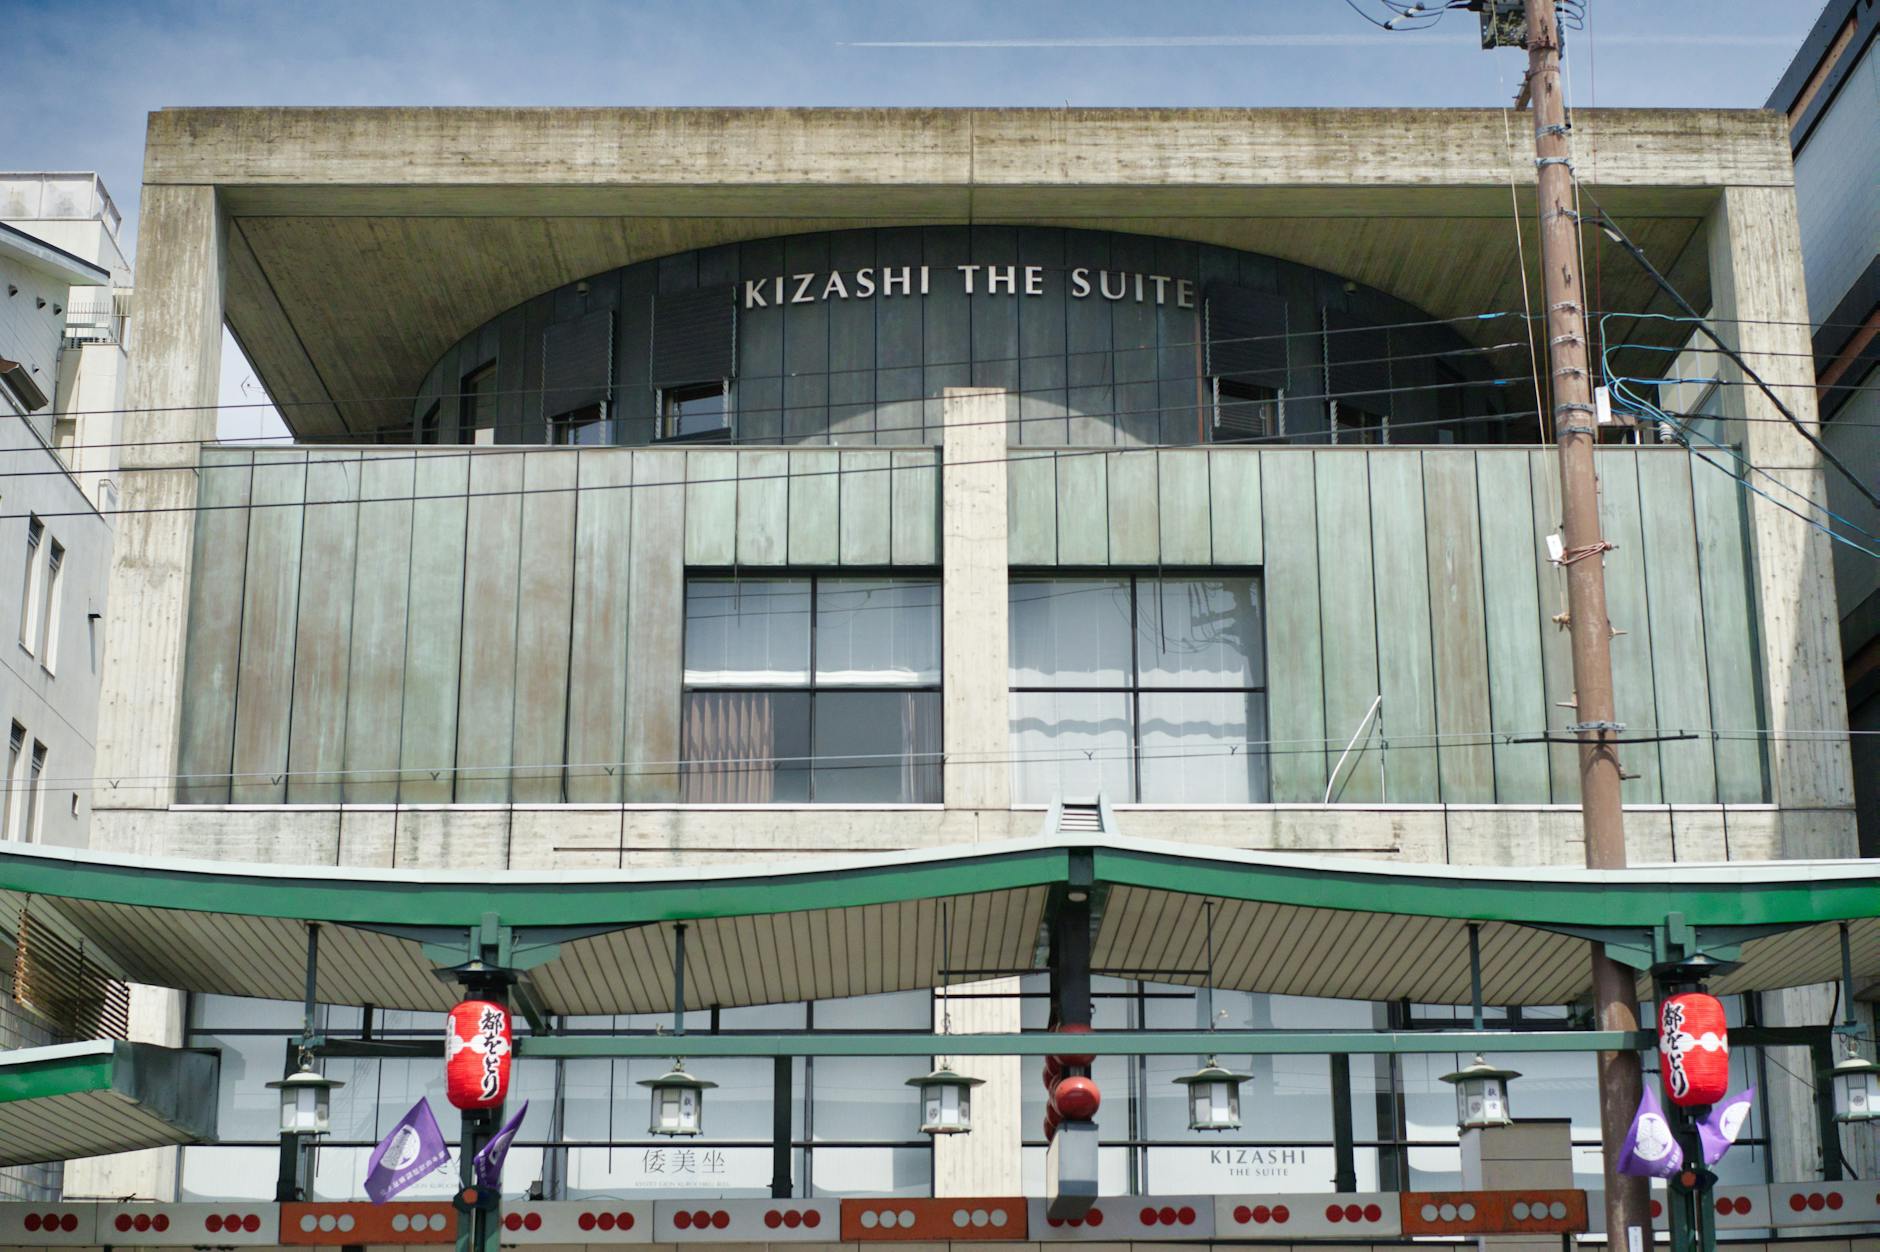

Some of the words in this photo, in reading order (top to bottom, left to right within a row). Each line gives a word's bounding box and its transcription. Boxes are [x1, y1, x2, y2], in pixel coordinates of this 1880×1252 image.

[744, 265, 930, 309] KIZASHI
[957, 265, 1043, 296] THE
[1071, 267, 1195, 309] SUITE
[480, 1008, 504, 1099] 都をどり
[1210, 1149, 1306, 1164] KIZASHI
[1229, 1168, 1250, 1177] THE
[1255, 1168, 1289, 1177] SUITE
